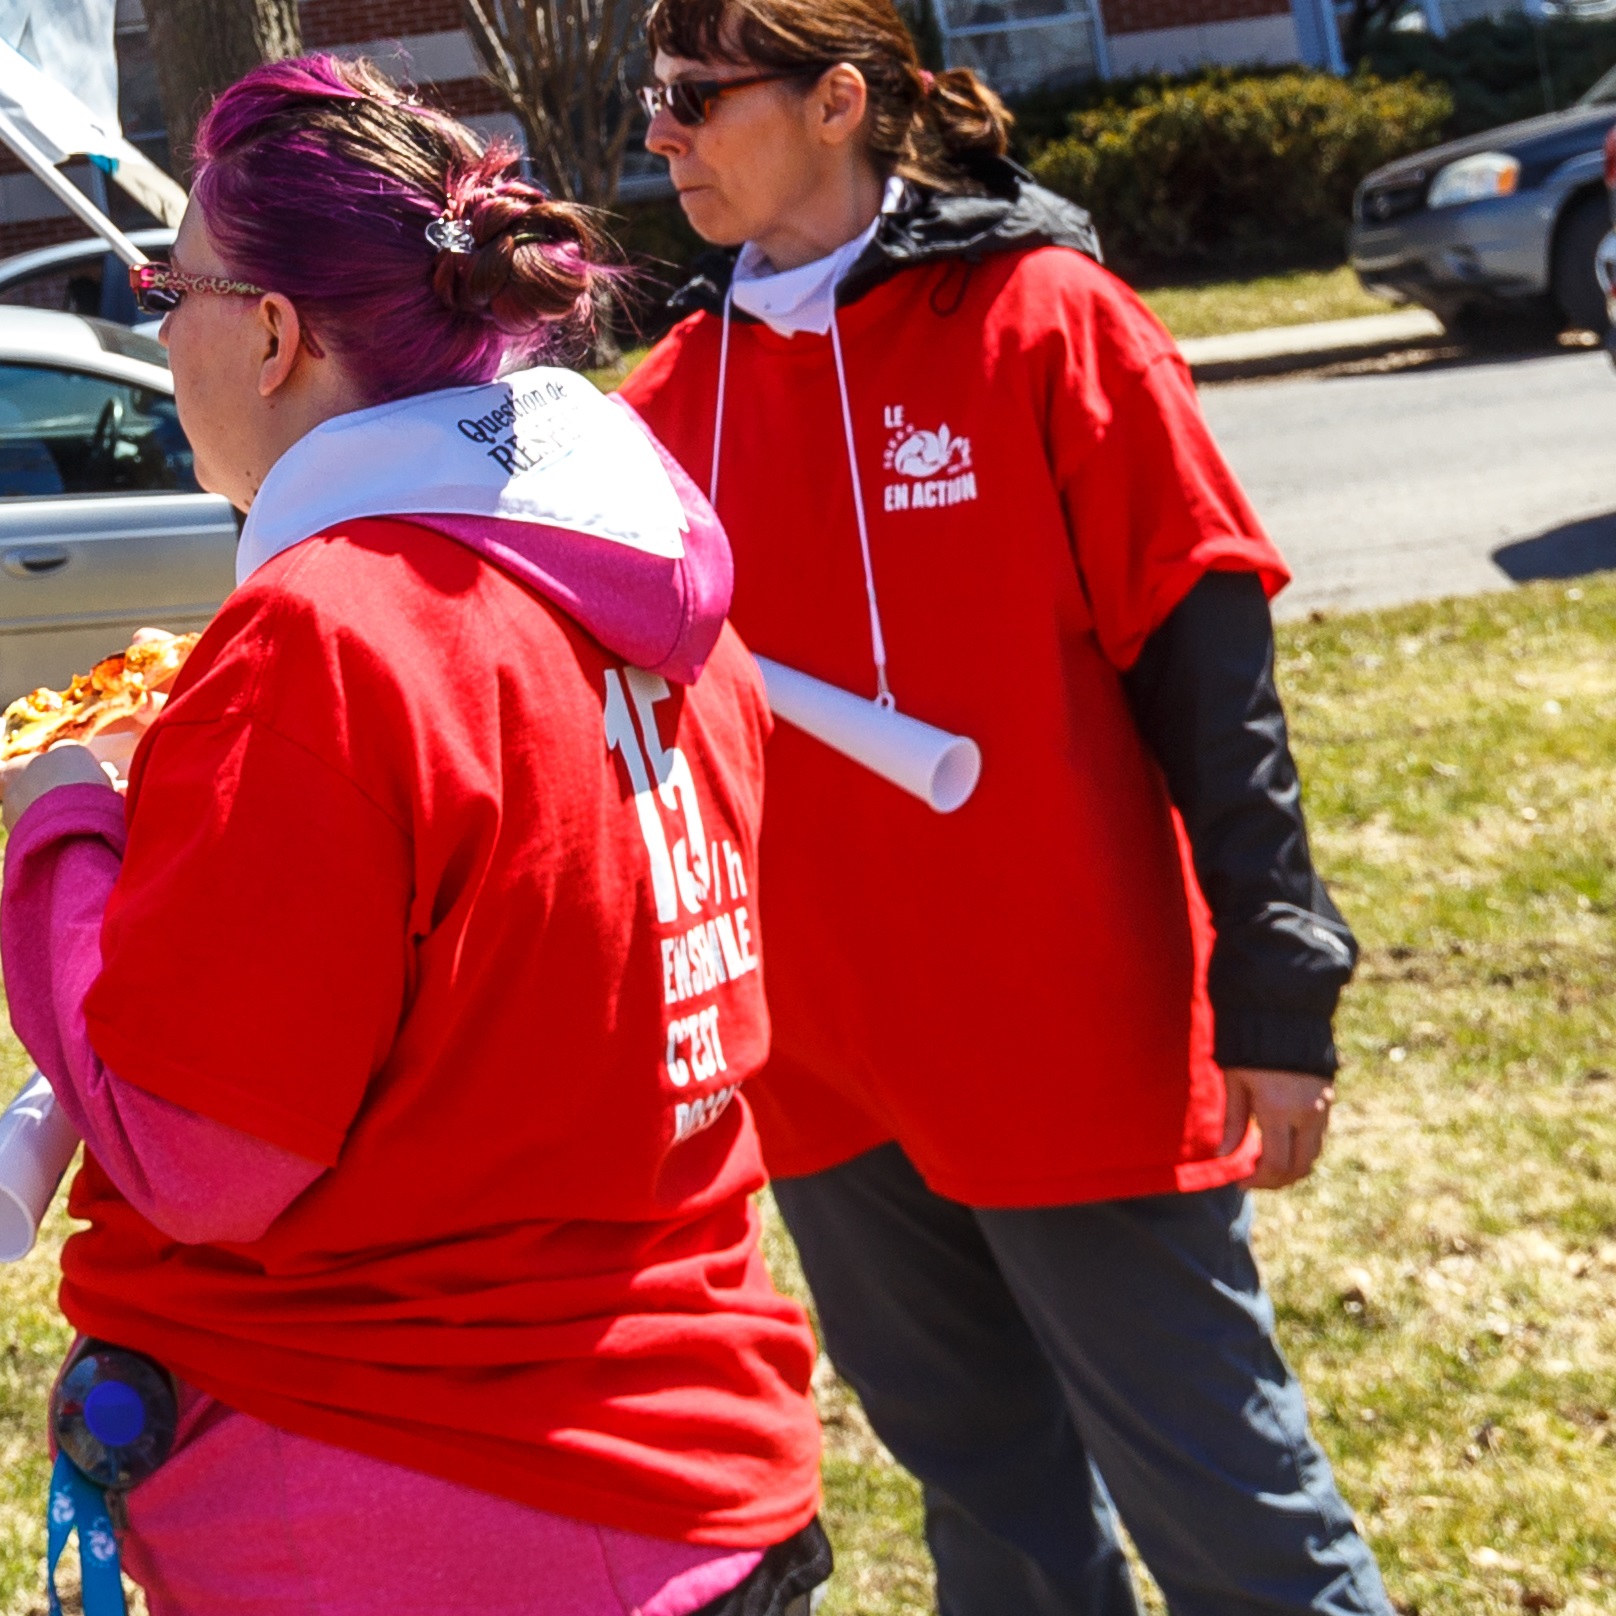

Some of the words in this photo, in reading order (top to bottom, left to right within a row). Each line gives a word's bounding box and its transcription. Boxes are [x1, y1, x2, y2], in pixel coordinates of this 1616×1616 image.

[457, 389, 548, 444] Question
[884, 404, 904, 429] LE
[884, 482, 909, 512] EN
[912, 472, 978, 509] ACTION
[604, 665, 710, 925] 15
[660, 906, 761, 1005] ENSEMLE
